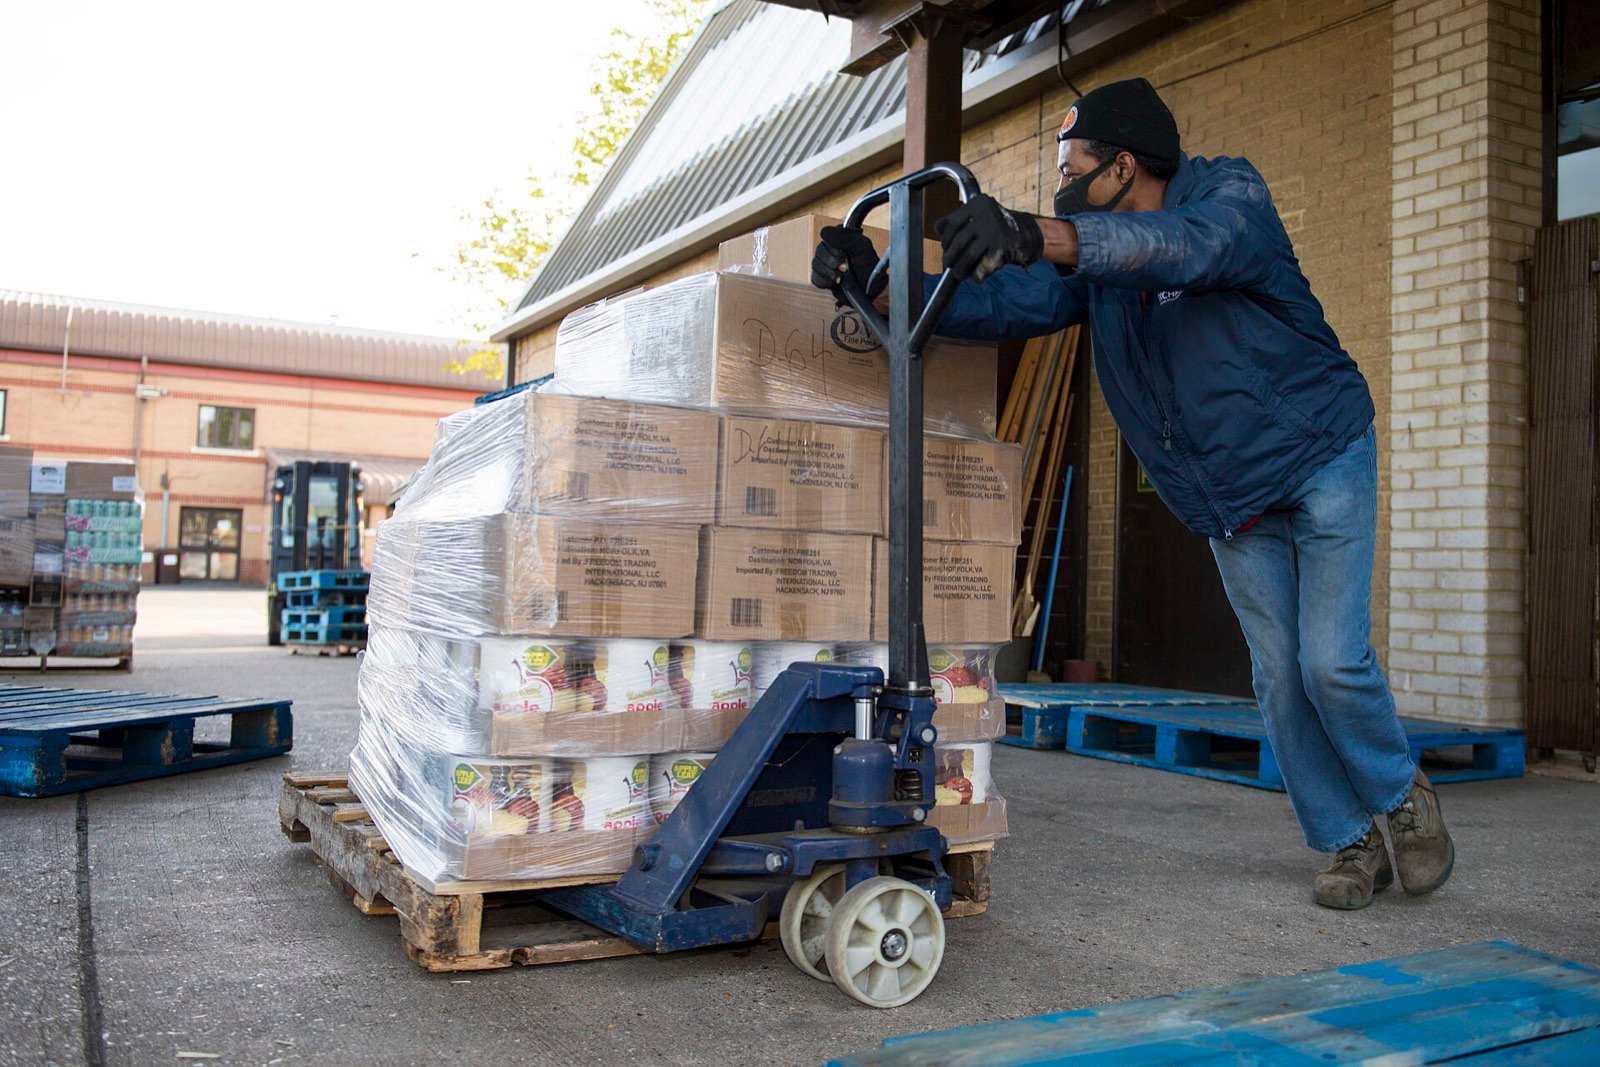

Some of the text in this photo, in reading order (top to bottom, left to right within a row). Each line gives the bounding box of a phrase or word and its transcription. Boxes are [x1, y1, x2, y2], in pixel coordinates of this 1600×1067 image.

[845, 335, 859, 344] Fine
[579, 419, 614, 428] Customer
[751, 455, 779, 465] Imported
[926, 452, 951, 460] Customer
[752, 546, 782, 555] Customer
[796, 548, 820, 557] FRE251
[624, 559, 656, 568] TRADING
[951, 557, 973, 565] FRE251
[585, 568, 660, 578] INTERNATIONAL, LLC
[736, 566, 764, 576] Imported
[765, 567, 773, 576] By
[808, 569, 837, 577] TRADING
[776, 578, 827, 586] INTERNATIONAL,
[924, 575, 931, 583] By
[776, 587, 820, 596] HACKENSACK,
[933, 584, 979, 592] INTERNATIONAL,
[626, 699, 663, 712] apple
[711, 698, 747, 709] apple
[456, 769, 477, 778] APPLE
[674, 765, 698, 773] APPLE
[458, 776, 472, 785] LEAF
